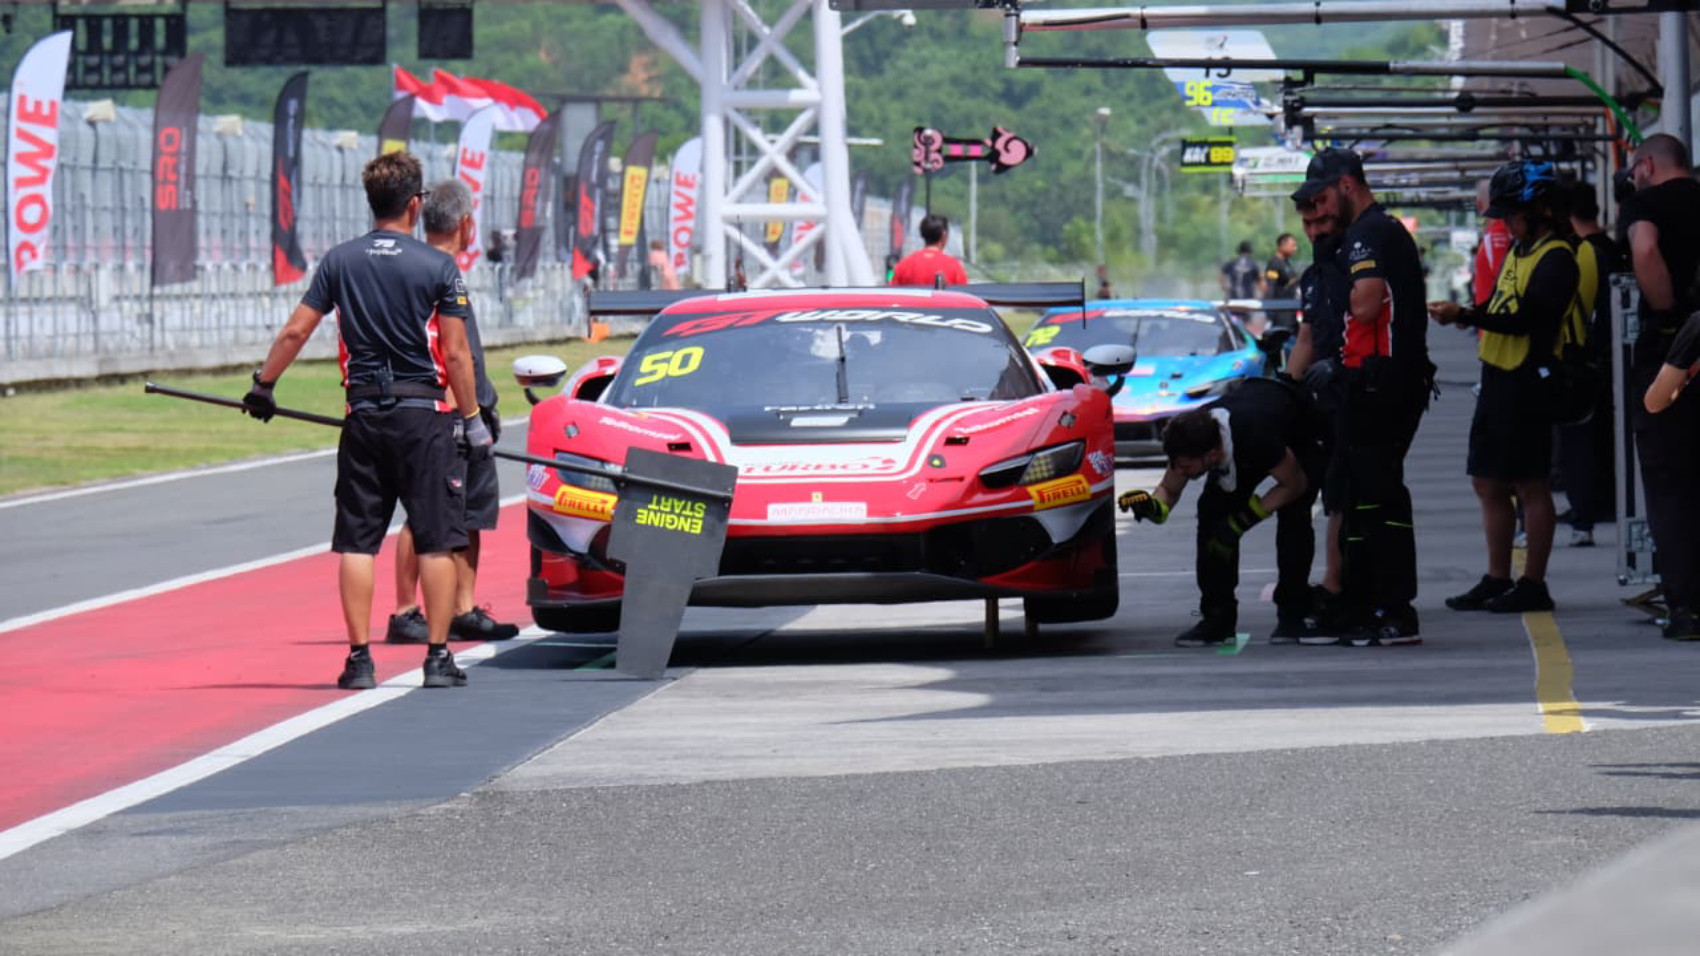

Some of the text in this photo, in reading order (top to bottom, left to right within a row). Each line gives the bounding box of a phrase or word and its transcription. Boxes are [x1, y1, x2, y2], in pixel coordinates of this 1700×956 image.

[1184, 81, 1212, 107] 96
[156, 127, 182, 211] SRO
[775, 309, 993, 333] WORLD
[634, 346, 705, 387] 50
[557, 490, 608, 516] PIRELLI
[1036, 480, 1088, 504] PIRELLI
[648, 494, 707, 518] START
[636, 508, 704, 535] ENGINE
